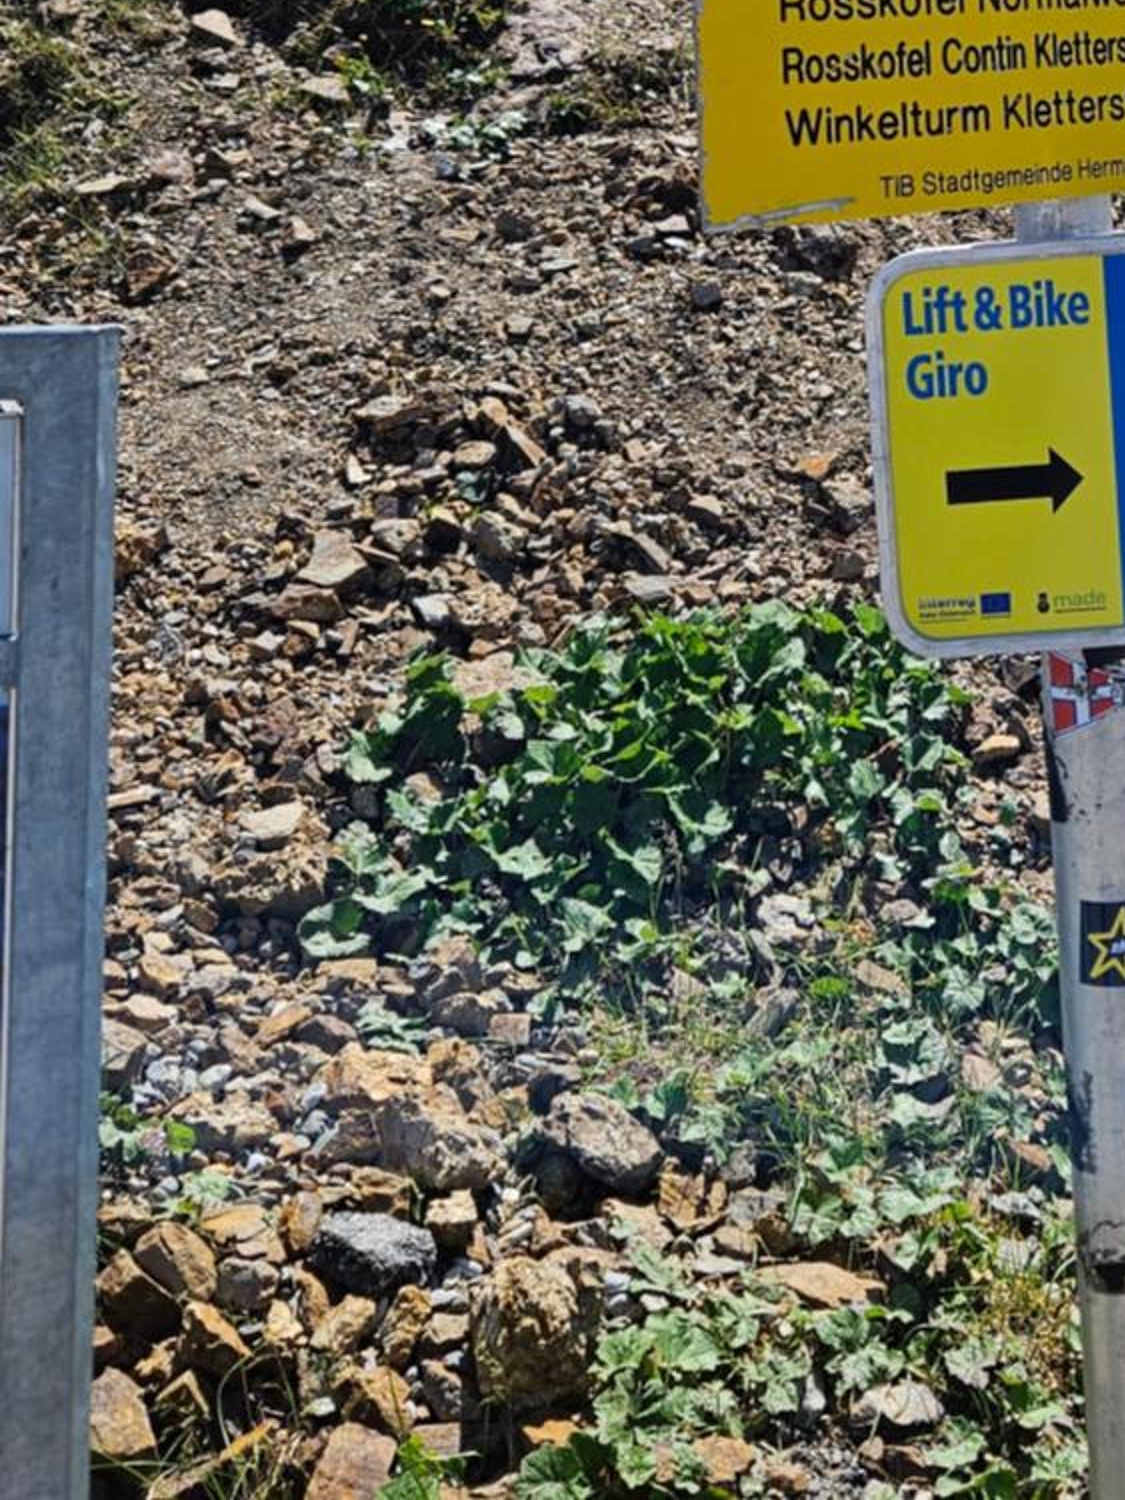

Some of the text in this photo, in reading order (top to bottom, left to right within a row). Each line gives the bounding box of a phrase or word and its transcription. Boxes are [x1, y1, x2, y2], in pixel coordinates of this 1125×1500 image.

[782, 40, 932, 85] Rosskofel
[941, 35, 1027, 75] Contin
[785, 101, 990, 147] Winkelturm
[879, 174, 915, 198] TIB
[922, 163, 1073, 196] Stadtgemeinde
[902, 285, 968, 336] Lift
[1009, 280, 1090, 329] Bike
[906, 350, 988, 400] Giro
